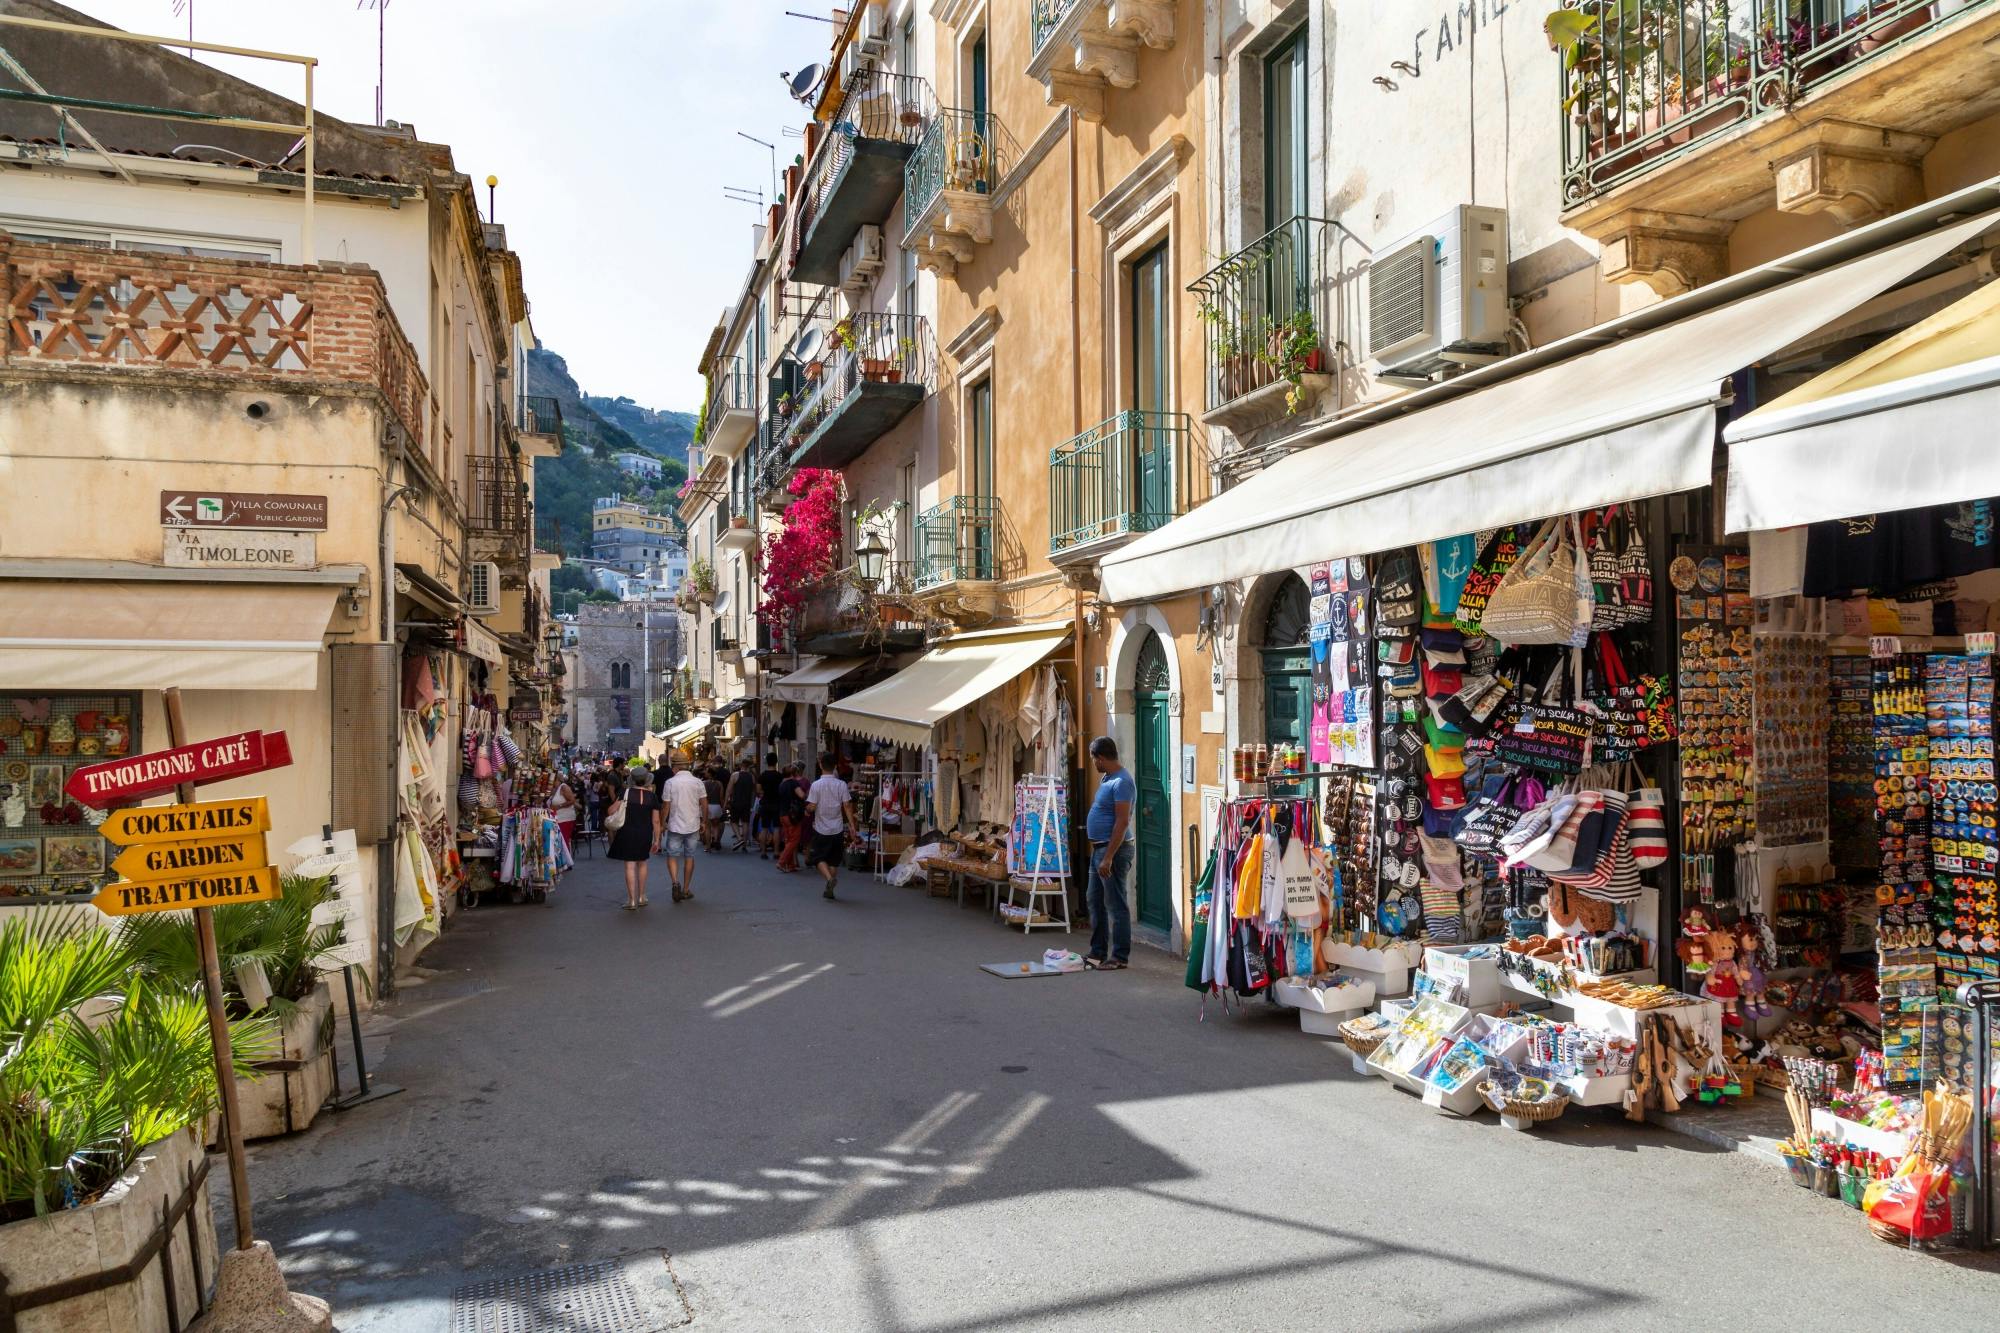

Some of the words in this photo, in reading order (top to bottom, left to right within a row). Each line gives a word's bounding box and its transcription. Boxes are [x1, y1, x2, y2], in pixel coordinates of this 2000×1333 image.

[231, 500, 261, 509] VILLA
[264, 501, 324, 511] COMUNALE
[256, 514, 283, 522] PUBLIC
[286, 515, 323, 524] GARDENS
[177, 534, 200, 544] VIA
[185, 546, 295, 563] TIMOLEONE
[1547, 708, 1575, 721] SICILIA
[1400, 733, 1417, 751] ITALIA
[1540, 732, 1568, 746] SICILIA
[1521, 743, 1548, 755] SICILIA
[85, 752, 195, 793] TIMOLEONE
[201, 735, 250, 768] CAFÉ
[1504, 751, 1531, 764] SICILIA
[122, 806, 253, 836] COCKTAILS
[146, 842, 244, 871] GARDEN
[118, 875, 260, 908] TRATTORIA
